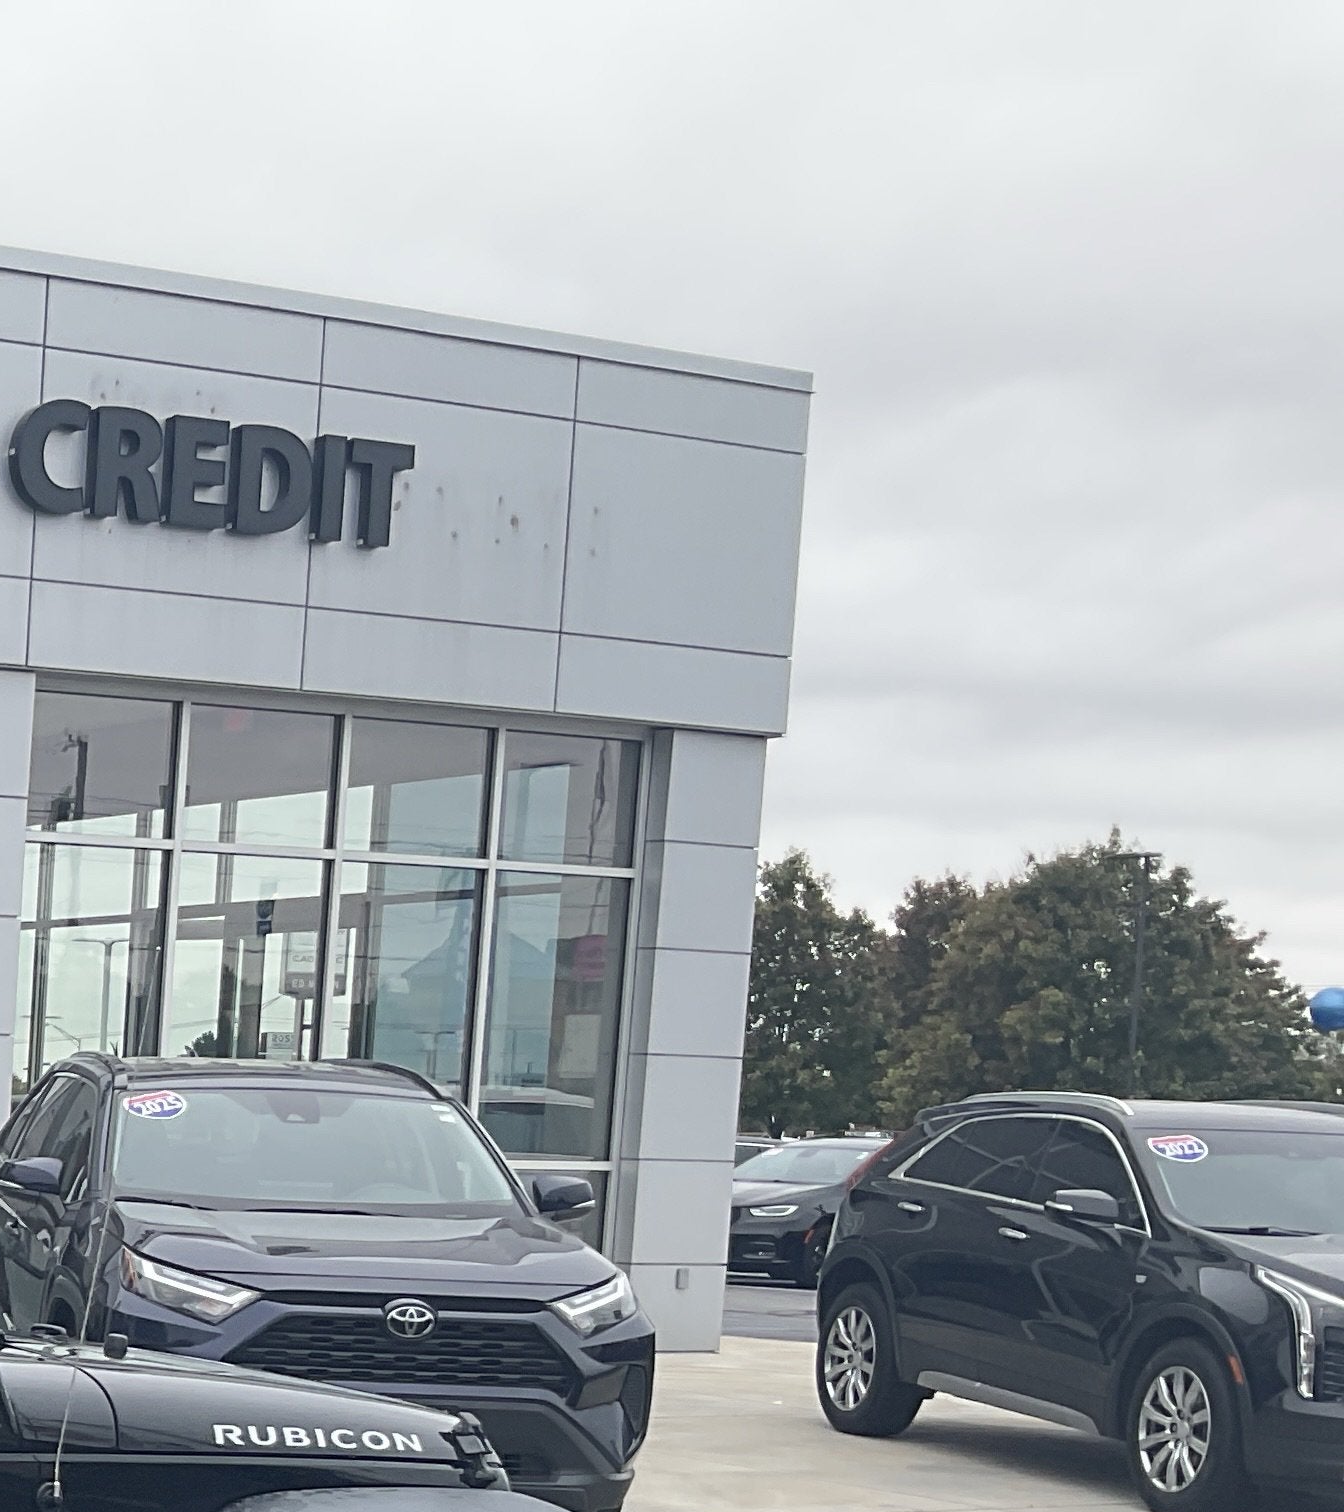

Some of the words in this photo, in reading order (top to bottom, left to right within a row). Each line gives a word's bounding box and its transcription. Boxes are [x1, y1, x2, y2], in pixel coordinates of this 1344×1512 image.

[9, 398, 416, 549] CREDIT
[133, 1096, 183, 1116] 2025
[1157, 1140, 1204, 1156] 2022
[212, 1424, 423, 1452] RUBICON
